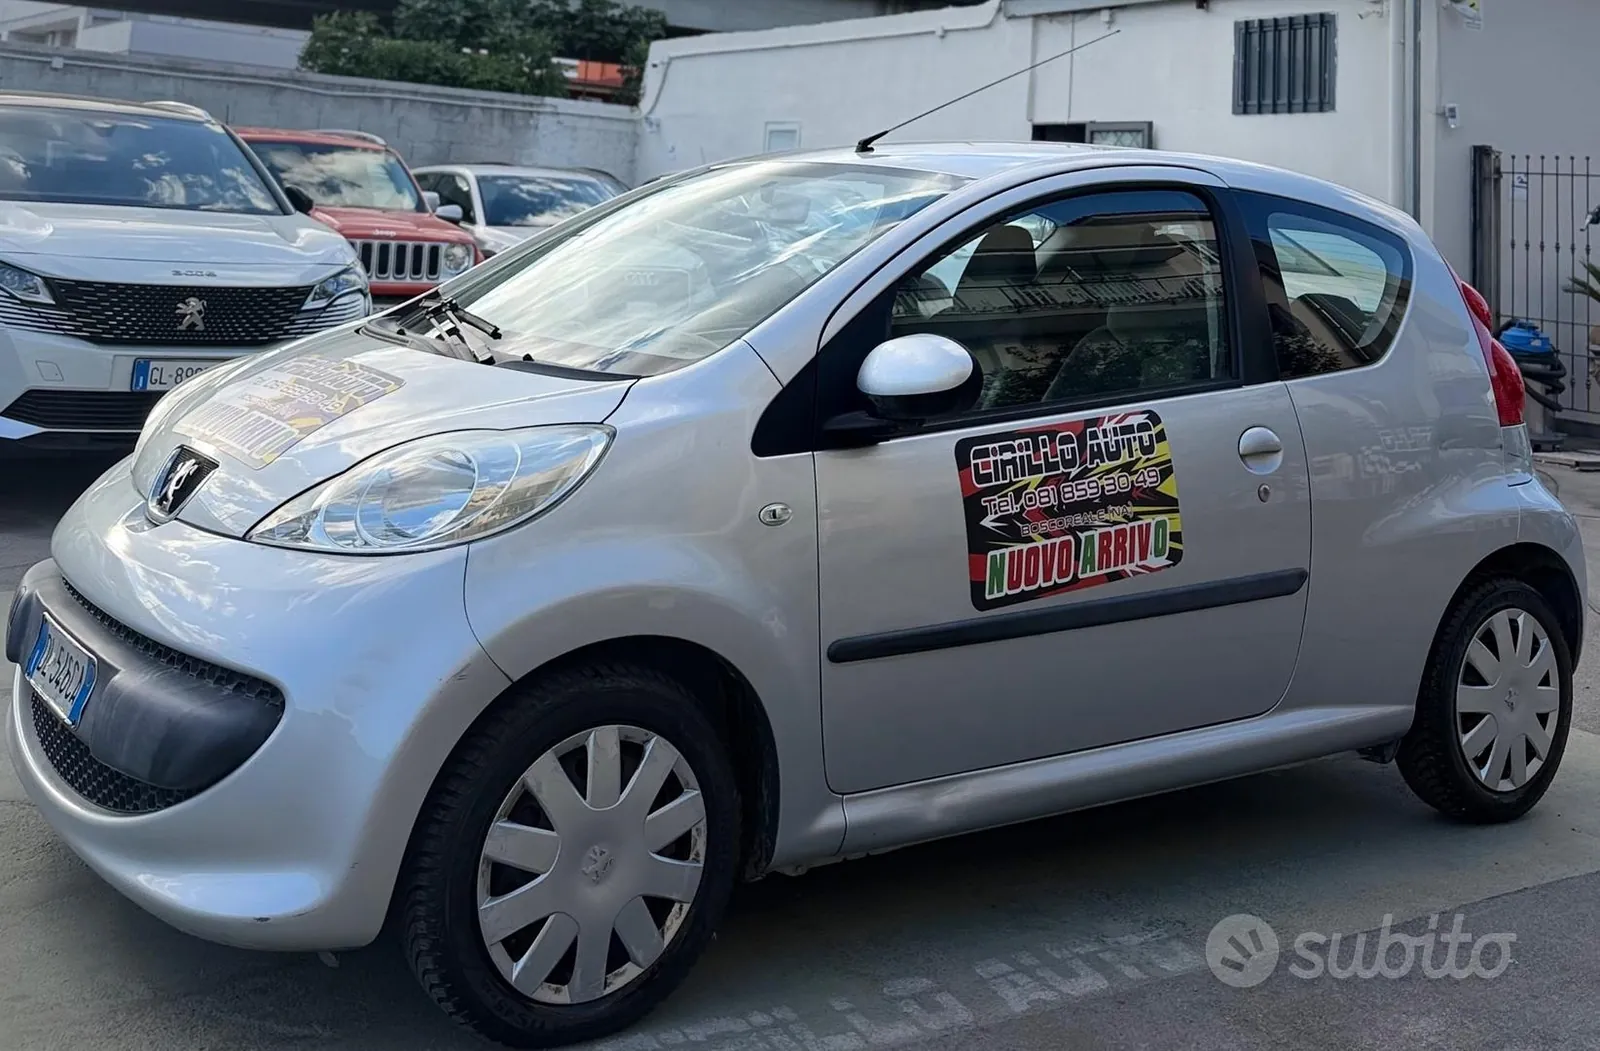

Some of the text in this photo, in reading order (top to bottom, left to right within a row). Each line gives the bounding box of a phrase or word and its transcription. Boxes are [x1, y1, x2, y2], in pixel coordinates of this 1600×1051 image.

[150, 366, 168, 385] GL
[1086, 421, 1157, 468] AUTO
[981, 468, 1161, 517] Tel. 081 859 30 49
[1020, 509, 1106, 537] BOSCOREALE
[985, 516, 1170, 600] NUOVO ARRIVO
